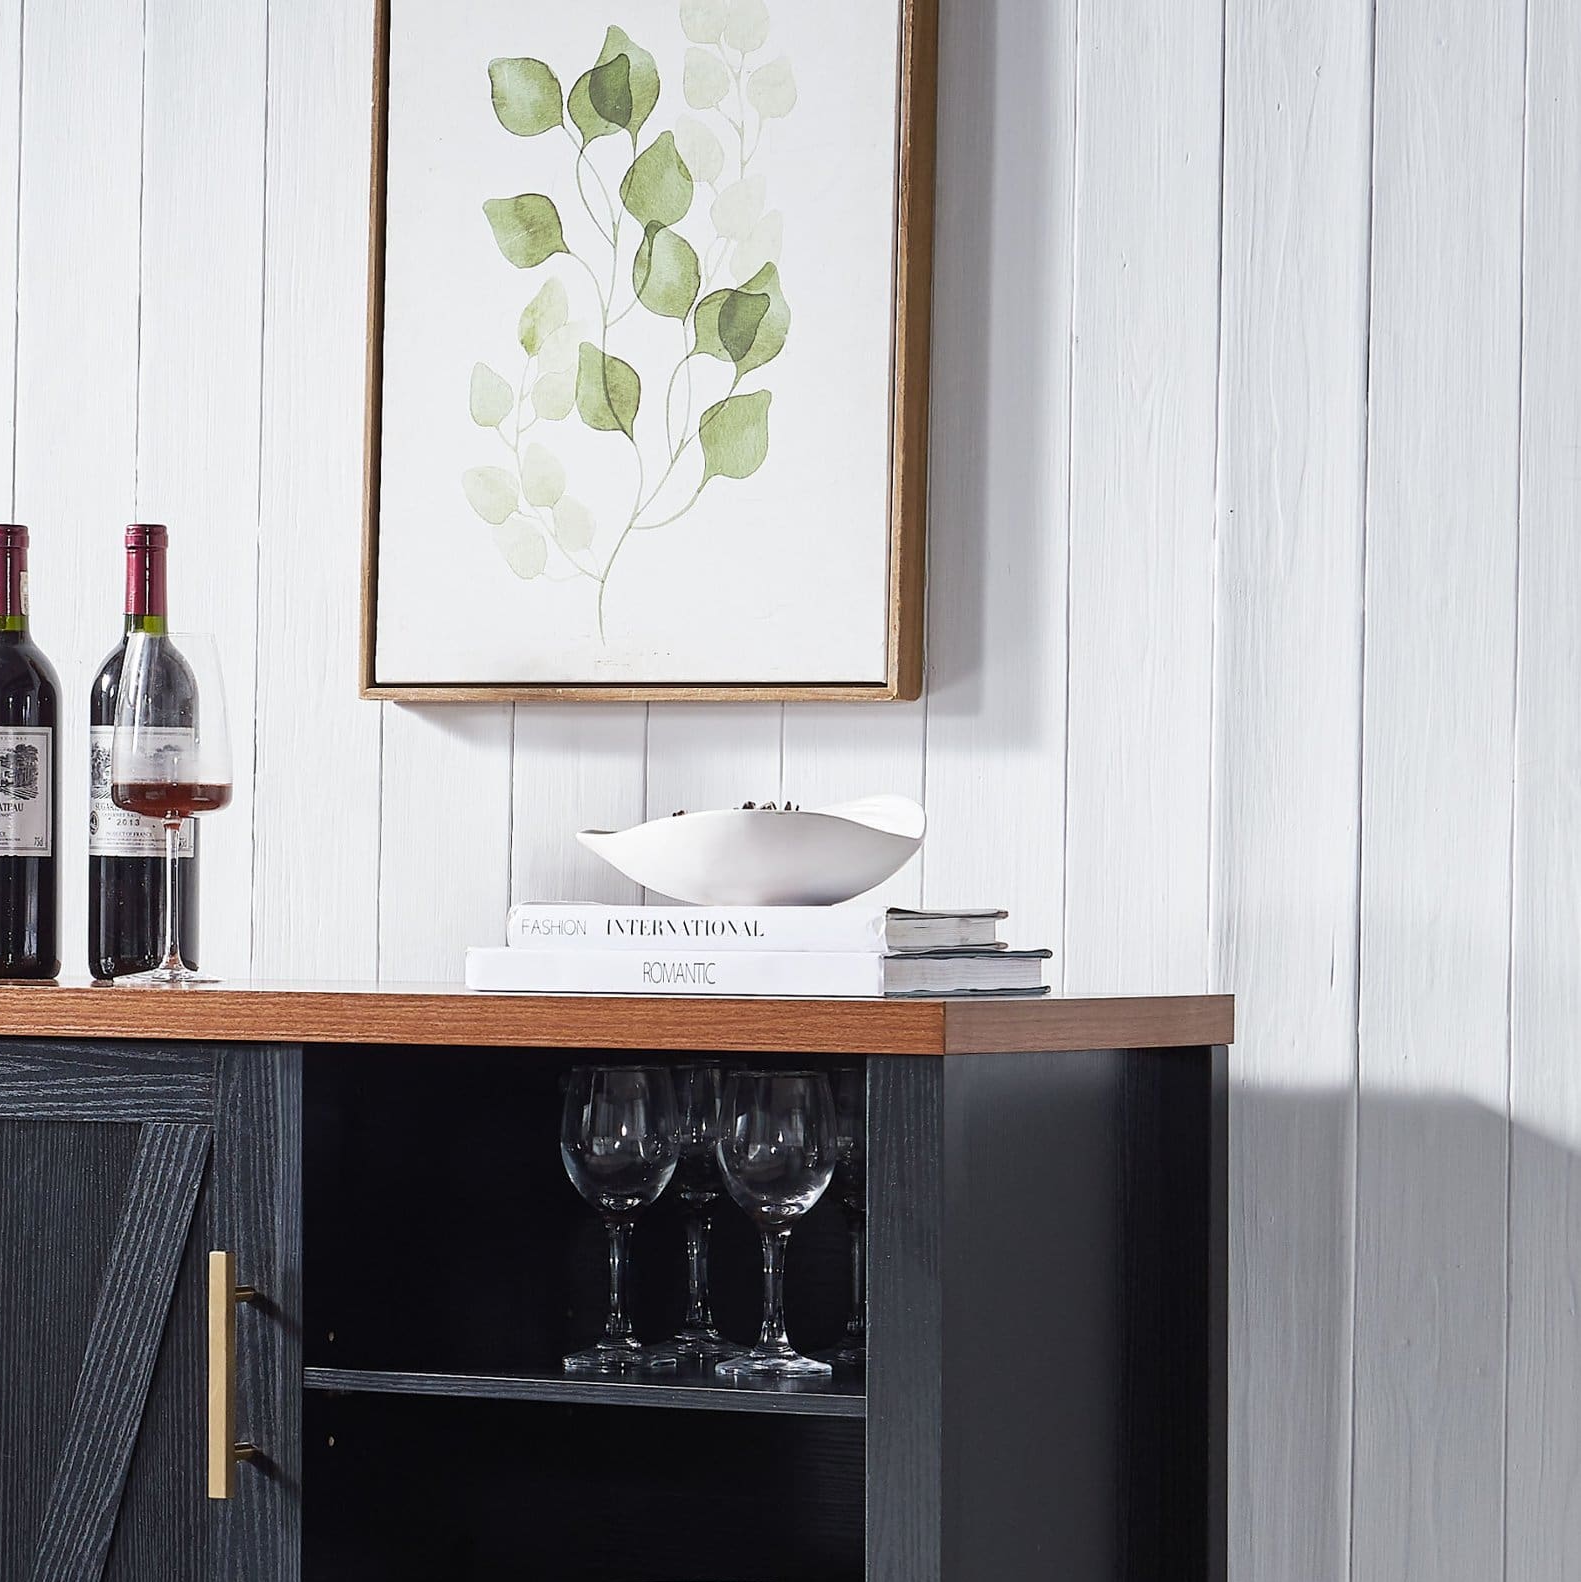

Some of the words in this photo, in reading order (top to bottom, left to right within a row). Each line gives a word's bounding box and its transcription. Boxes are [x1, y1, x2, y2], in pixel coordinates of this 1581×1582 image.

[116, 818, 140, 826] 2013
[521, 919, 587, 936] FASHION
[606, 919, 765, 937] INTERNATIONAL
[642, 961, 716, 985] ROMANTIC
